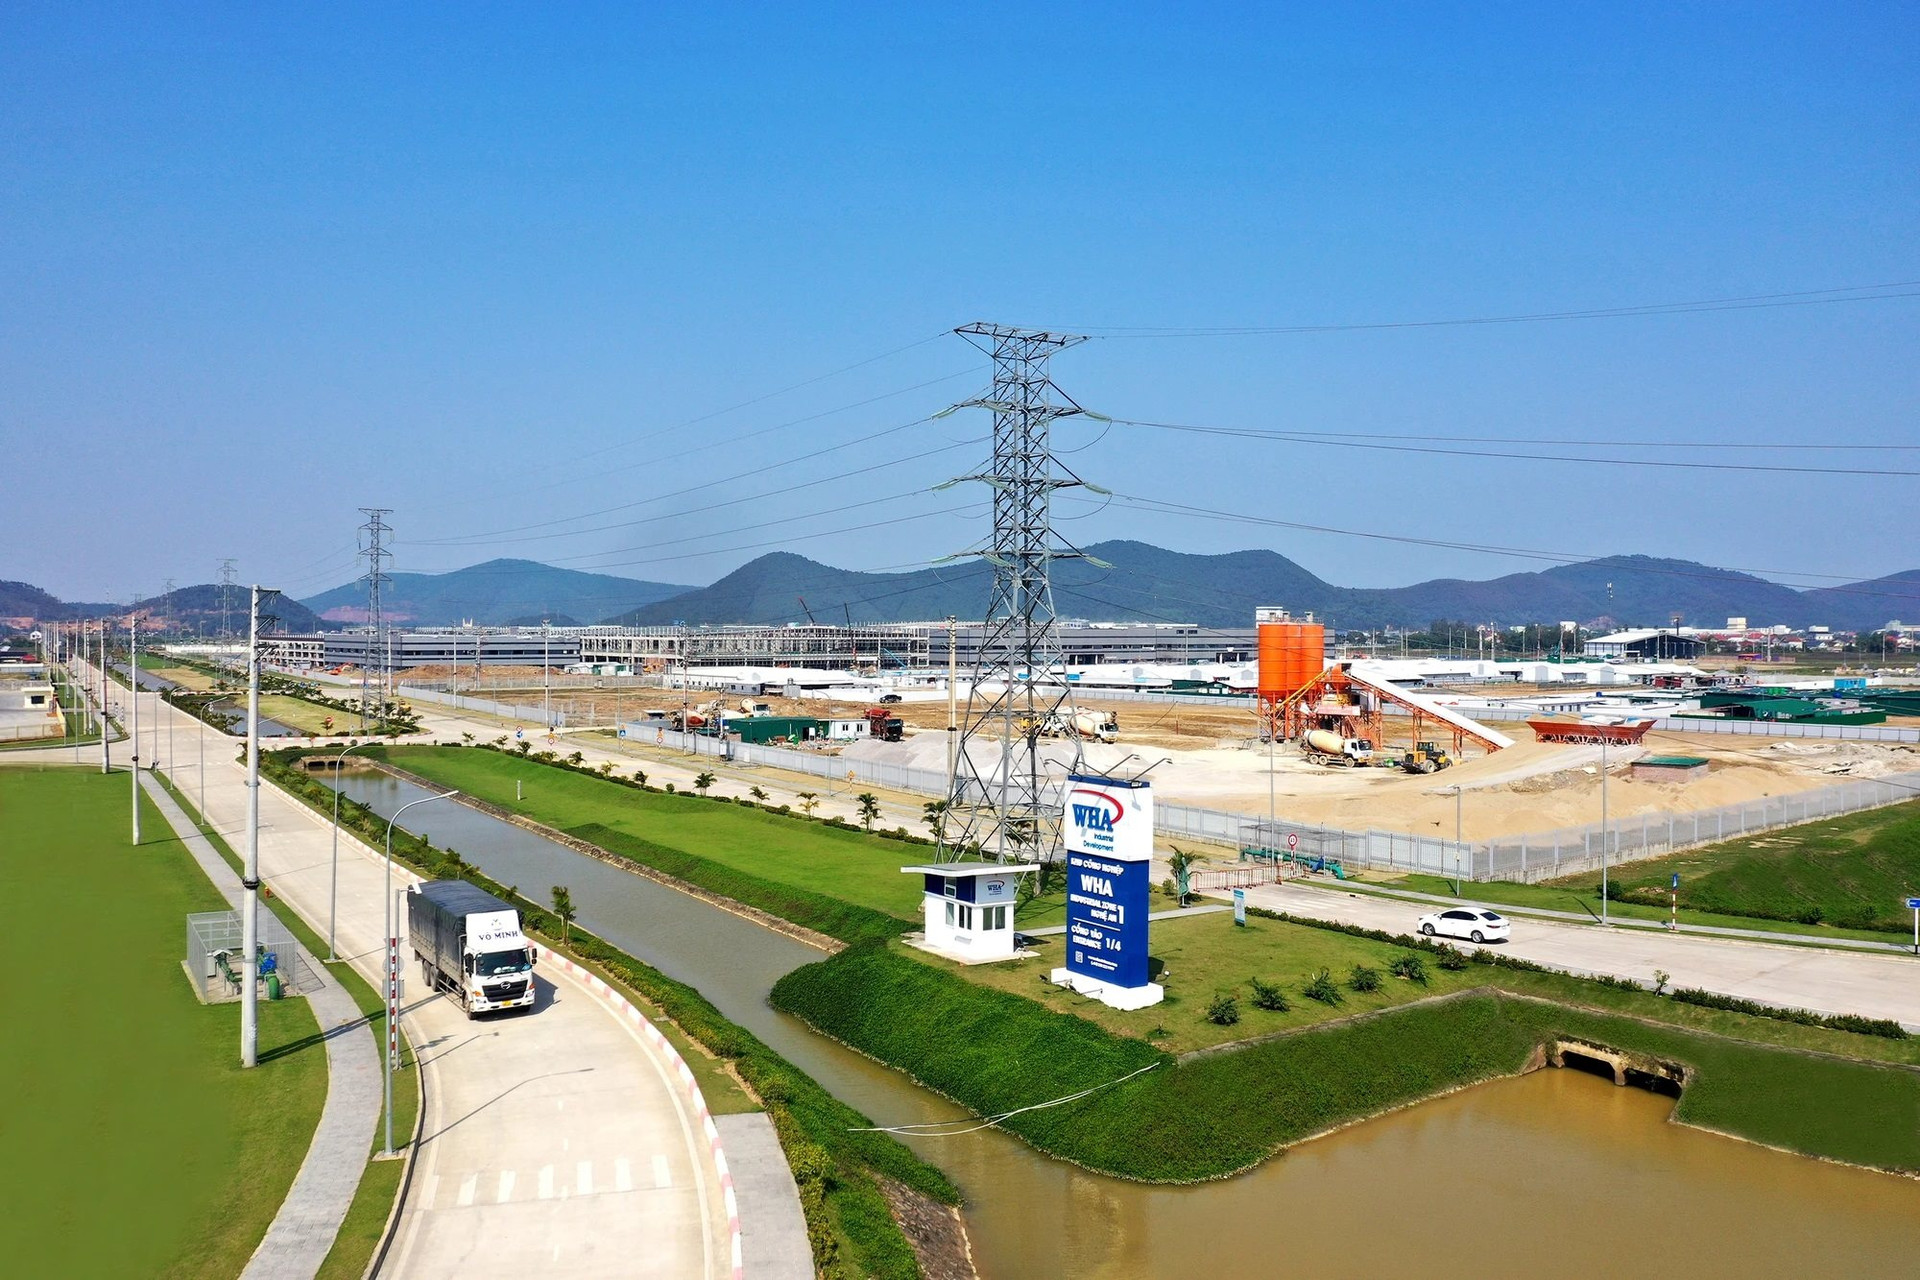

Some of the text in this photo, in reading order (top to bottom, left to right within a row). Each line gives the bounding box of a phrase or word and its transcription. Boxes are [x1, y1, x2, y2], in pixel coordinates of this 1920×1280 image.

[1072, 804, 1113, 832] WHA
[1083, 840, 1114, 852] Development
[1081, 874, 1113, 897] WHA
[1117, 905, 1124, 924] 1
[494, 931, 518, 939] MINH
[1106, 938, 1121, 951] 1/4
